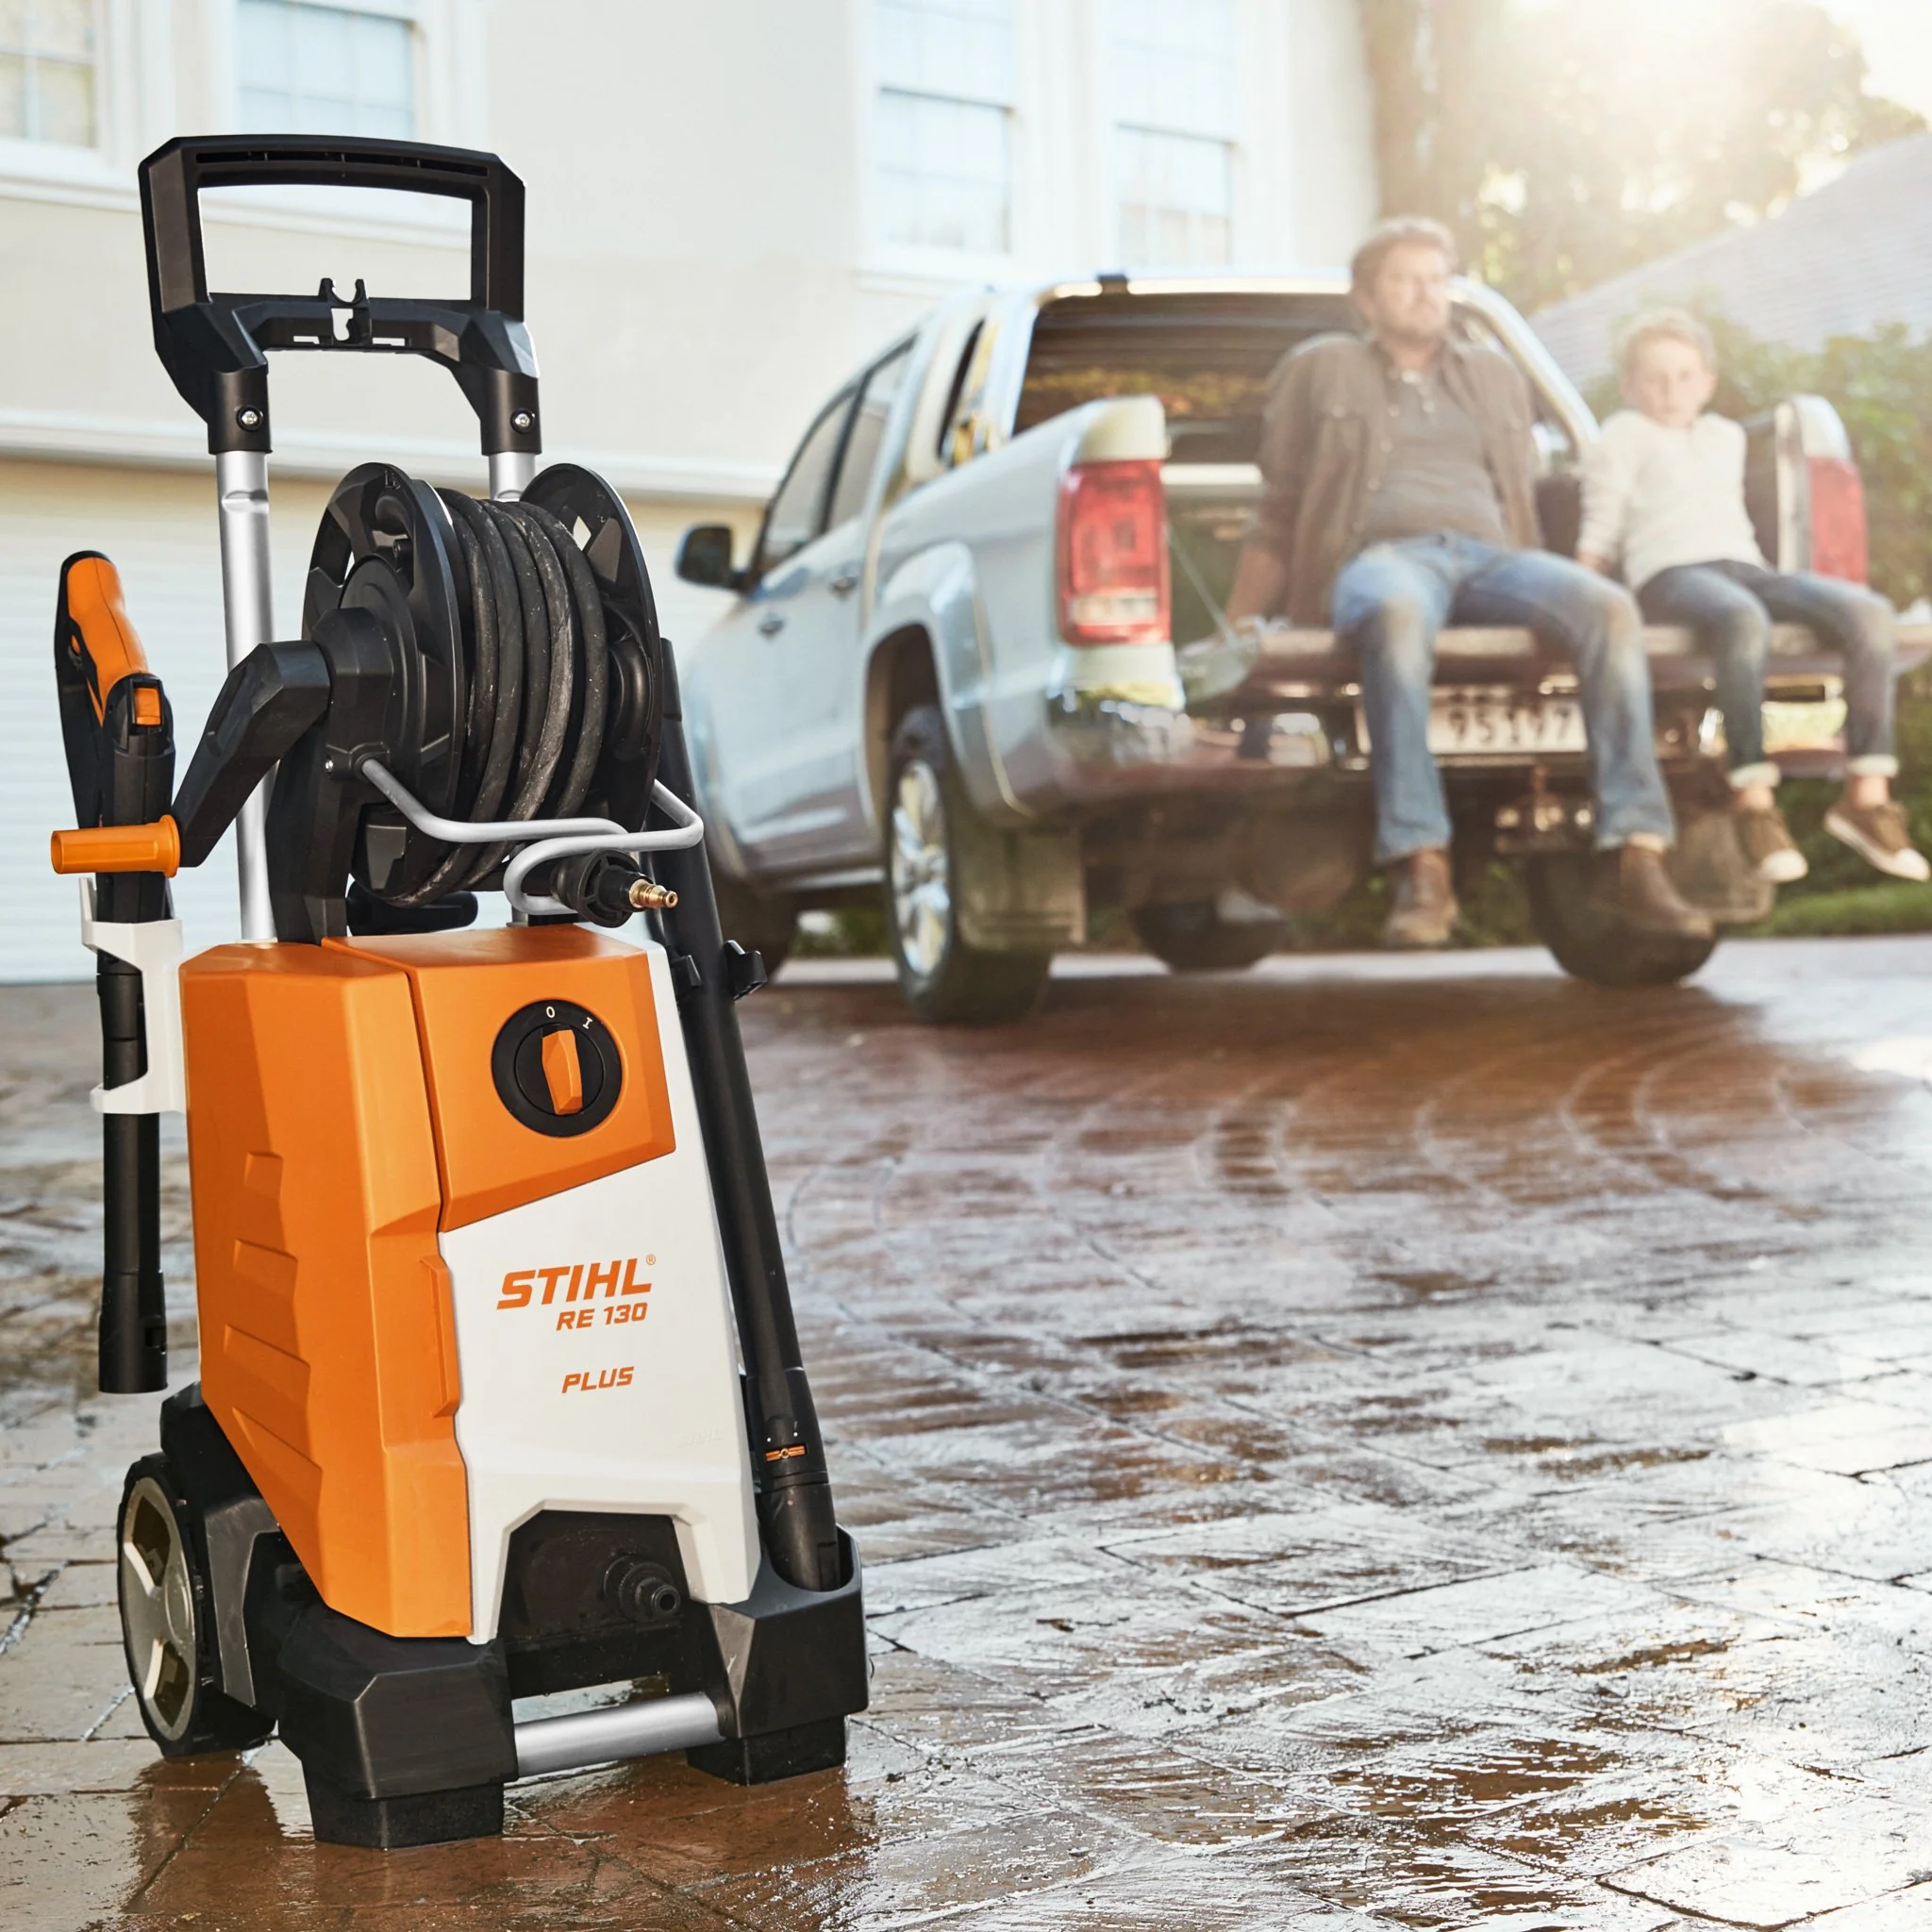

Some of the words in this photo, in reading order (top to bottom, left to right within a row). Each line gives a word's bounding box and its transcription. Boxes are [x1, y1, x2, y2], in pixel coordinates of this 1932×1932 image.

[556, 1308, 595, 1331] RE
[604, 1302, 648, 1325] 130
[561, 1366, 635, 1393] PLUS
